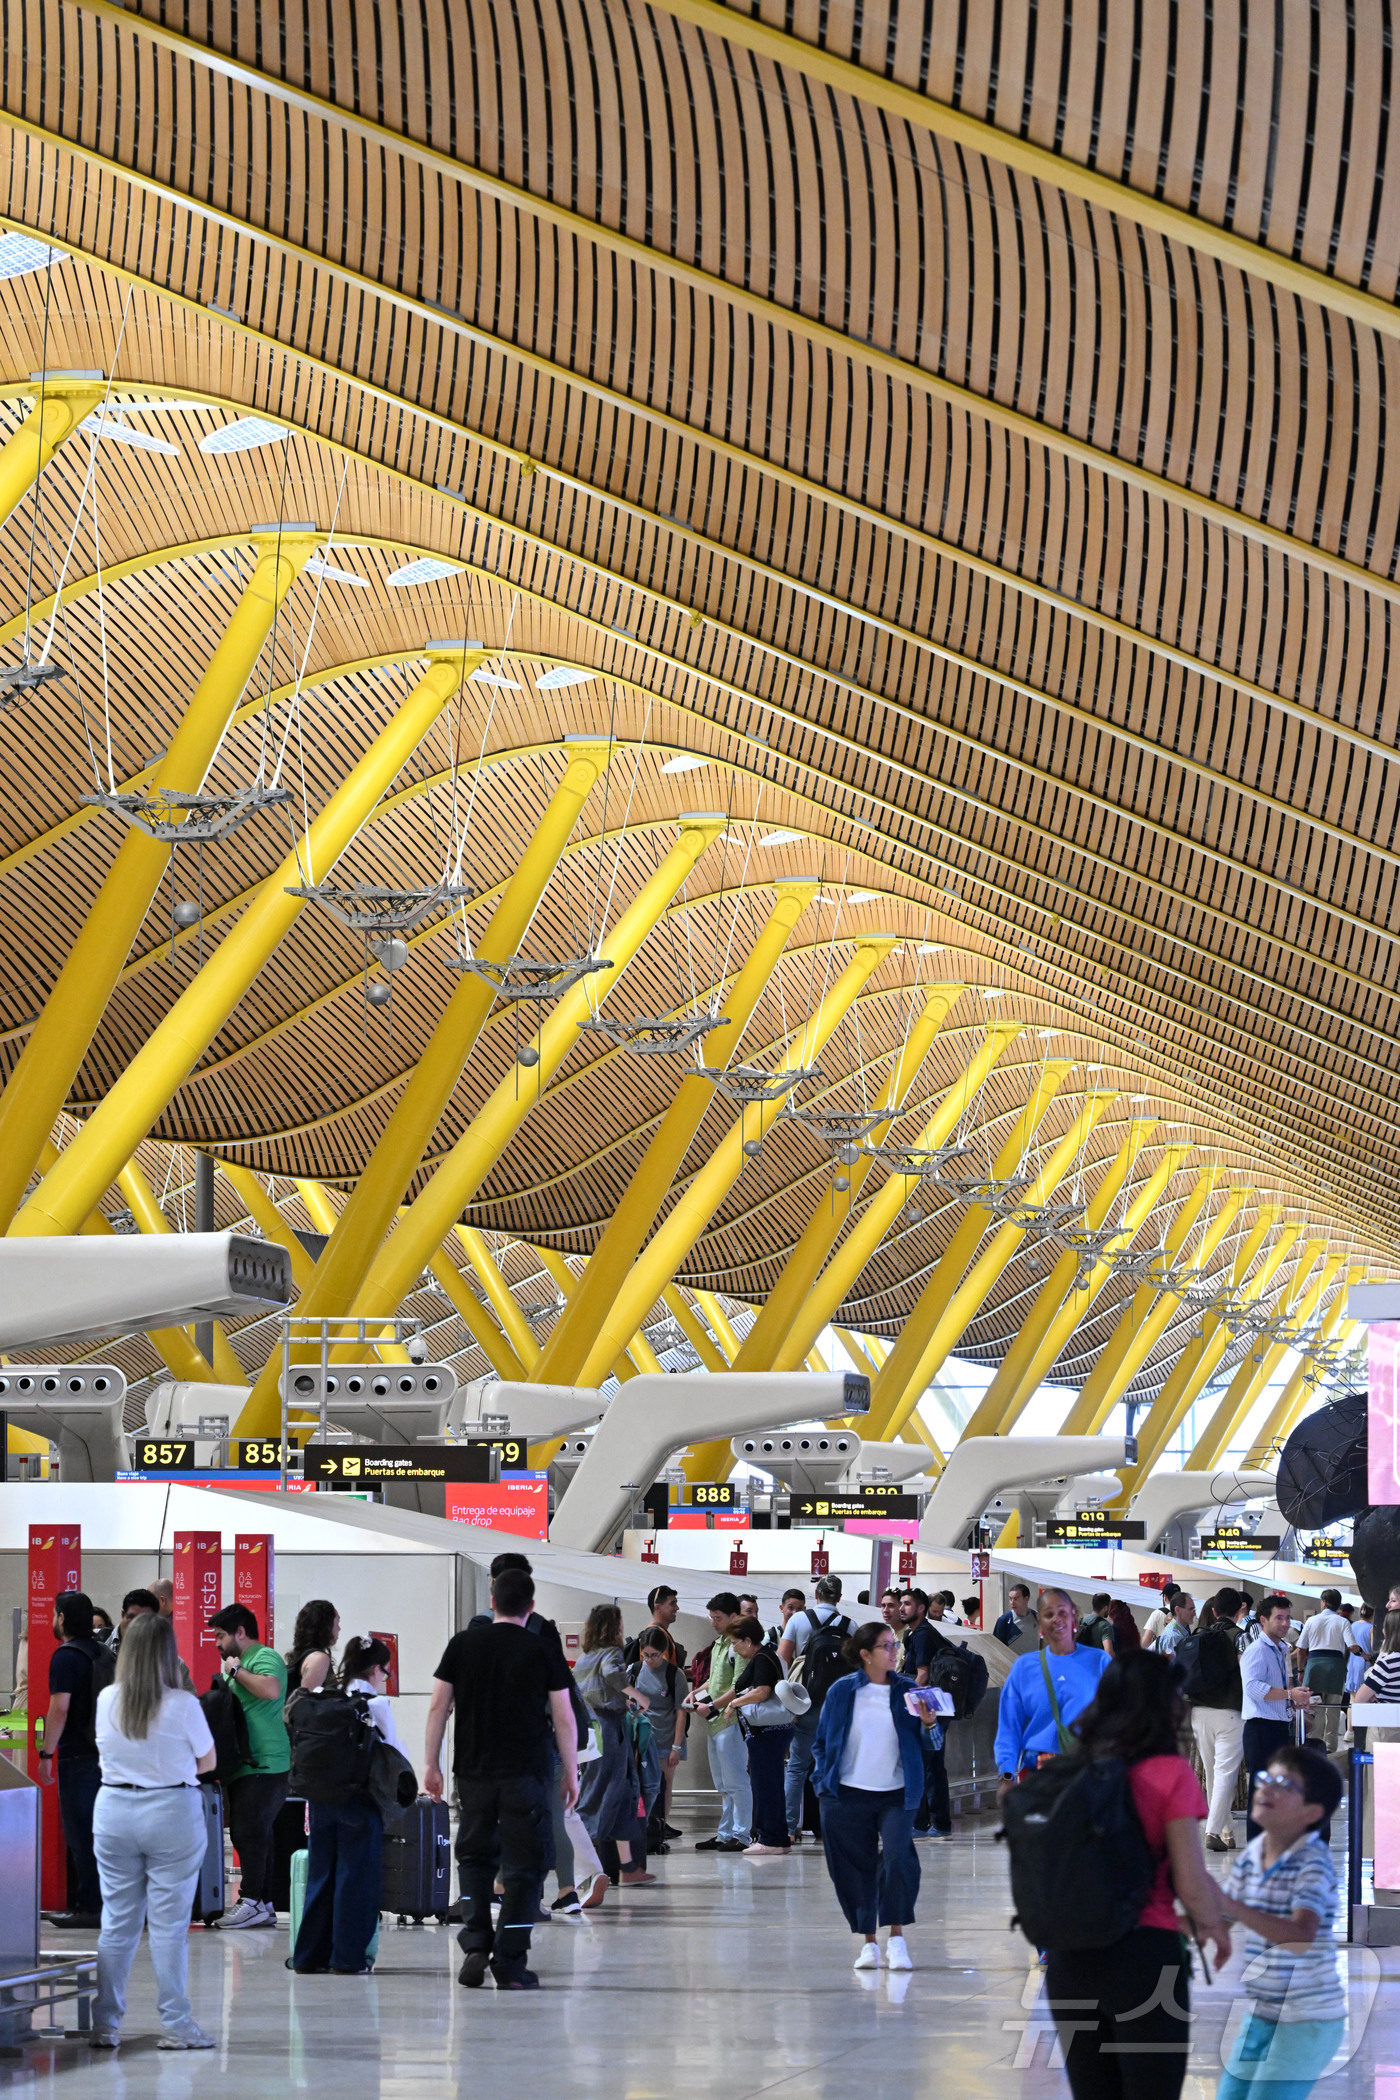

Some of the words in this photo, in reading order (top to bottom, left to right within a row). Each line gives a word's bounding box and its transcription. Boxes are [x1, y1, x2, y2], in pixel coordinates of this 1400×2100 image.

[143, 1444, 187, 1464] 857
[364, 1458, 393, 1468] Boarding
[394, 1459, 413, 1468] gates
[364, 1467, 395, 1476] Puertas
[395, 1467, 406, 1476] de
[407, 1467, 446, 1478] embarque
[696, 1487, 731, 1503] 888
[452, 1506, 485, 1518] Entrega
[486, 1505, 498, 1515] de
[499, 1506, 536, 1518] equipaje
[471, 1516, 492, 1528] drop
[32, 1537, 42, 1545] IB
[61, 1537, 70, 1545] IB
[175, 1542, 183, 1550] IB
[197, 1542, 207, 1550] IB
[733, 1559, 745, 1569] 19
[813, 1558, 827, 1568] 20
[901, 1559, 915, 1569] 21
